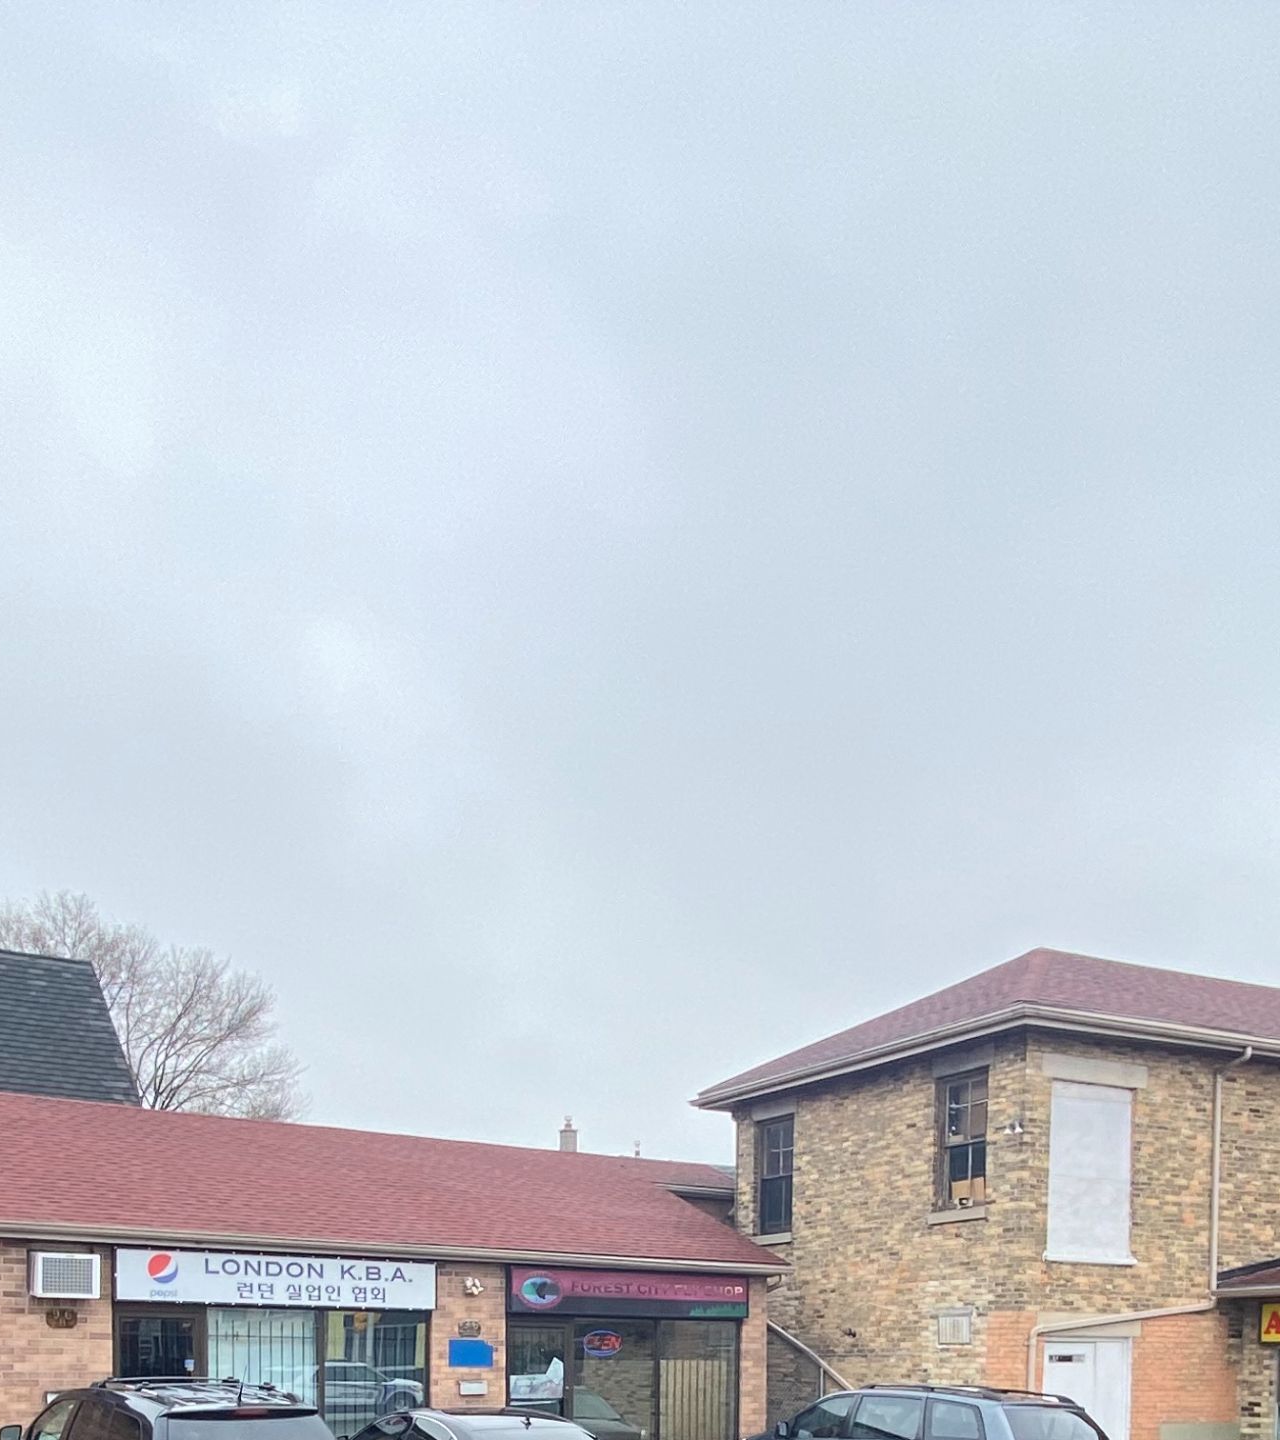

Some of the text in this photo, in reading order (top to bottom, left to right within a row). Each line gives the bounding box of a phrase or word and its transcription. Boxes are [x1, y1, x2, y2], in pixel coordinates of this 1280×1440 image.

[204, 1257, 414, 1283] LONDON K.B.A.
[237, 1281, 387, 1303] 런던 실업인 협회
[571, 1281, 633, 1294] FOREST
